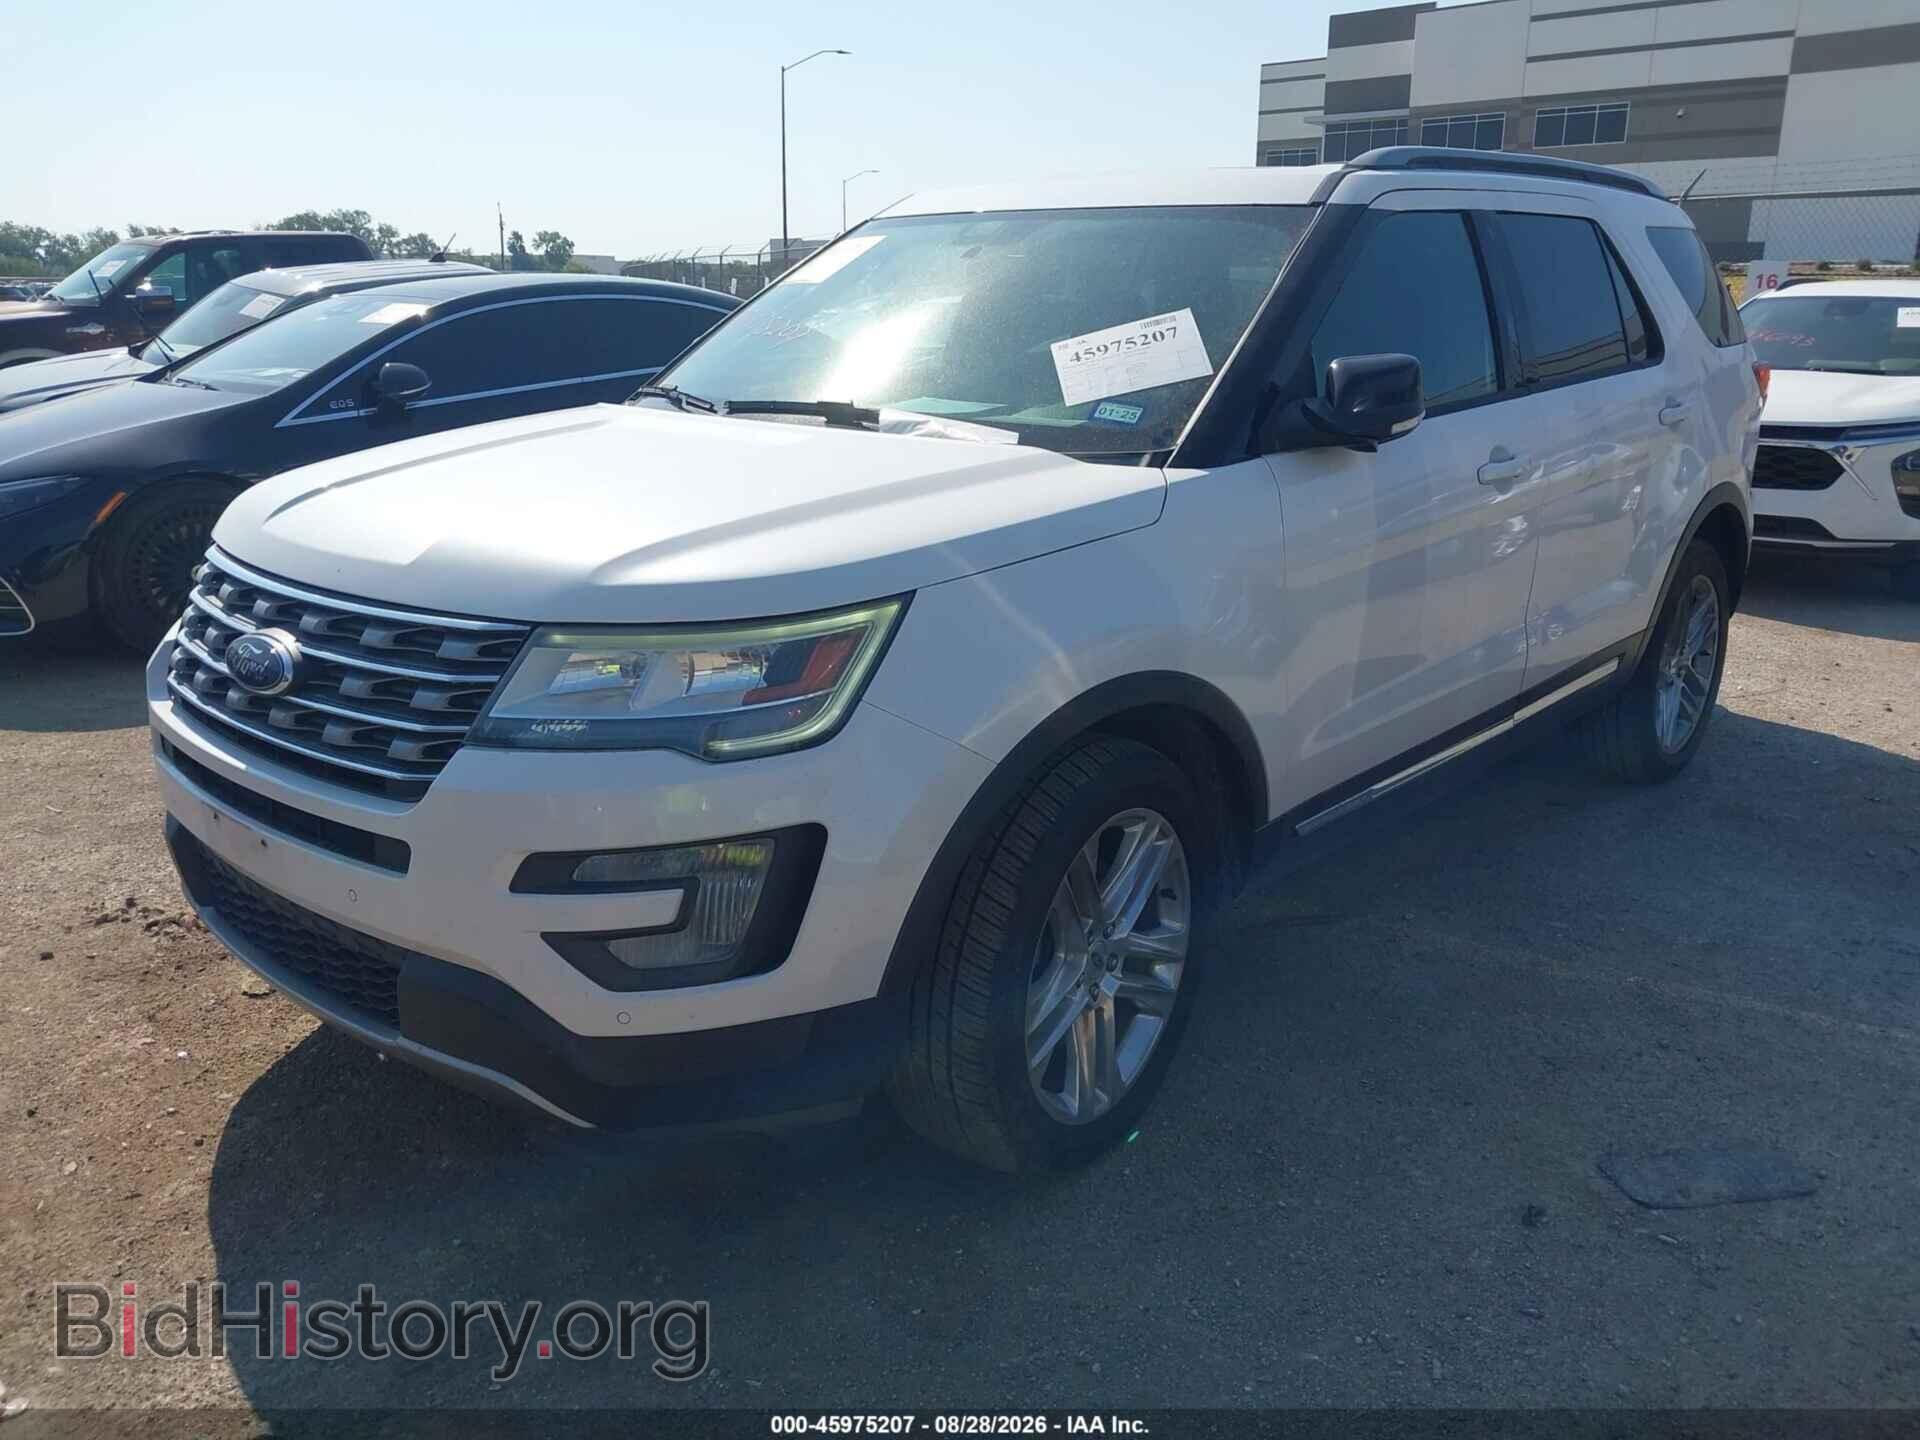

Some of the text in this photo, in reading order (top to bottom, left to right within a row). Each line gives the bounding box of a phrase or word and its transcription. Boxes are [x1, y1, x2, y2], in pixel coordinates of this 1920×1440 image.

[1755, 274, 1779, 290] 16
[1069, 326, 1178, 363] 45975207
[235, 642, 270, 675] Ford
